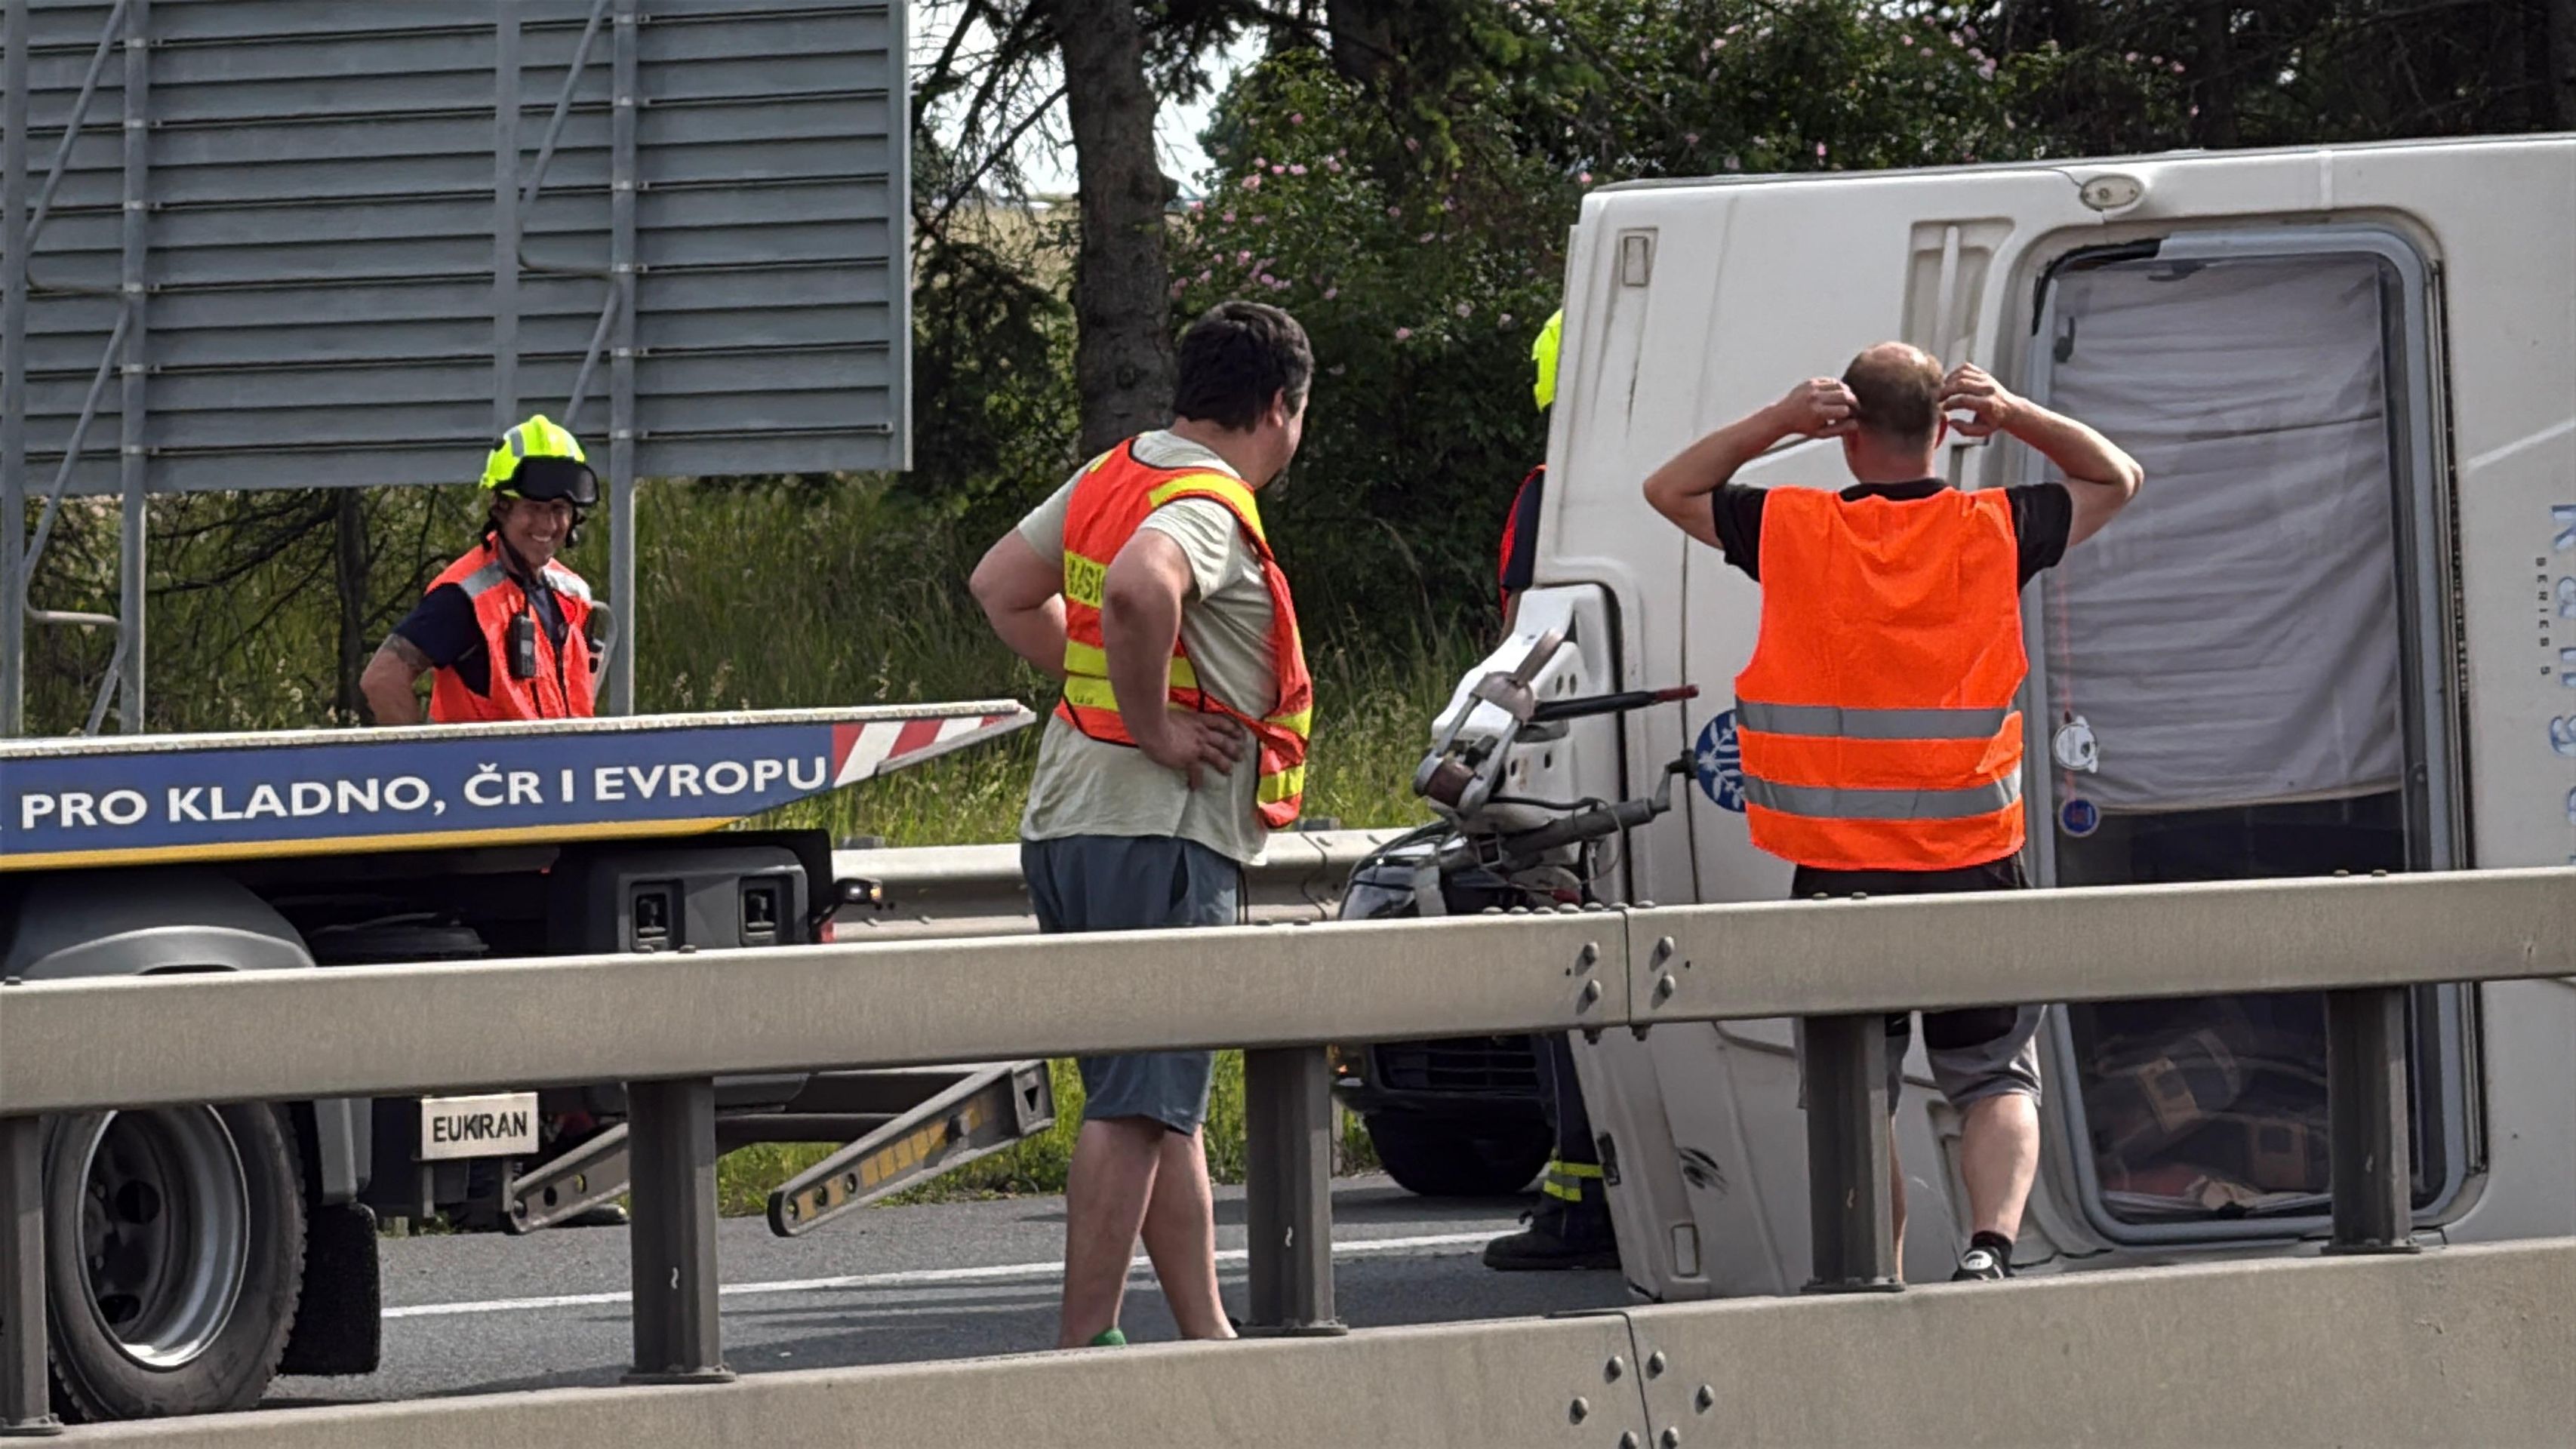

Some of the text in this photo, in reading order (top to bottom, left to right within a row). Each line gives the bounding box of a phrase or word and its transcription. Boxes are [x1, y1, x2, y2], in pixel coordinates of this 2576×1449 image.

[2536, 556, 2550, 648] SERIES
[22, 756, 826, 829] PRO KLADNO, ČR I EVROPU
[432, 1110, 527, 1143] EUKRAN
